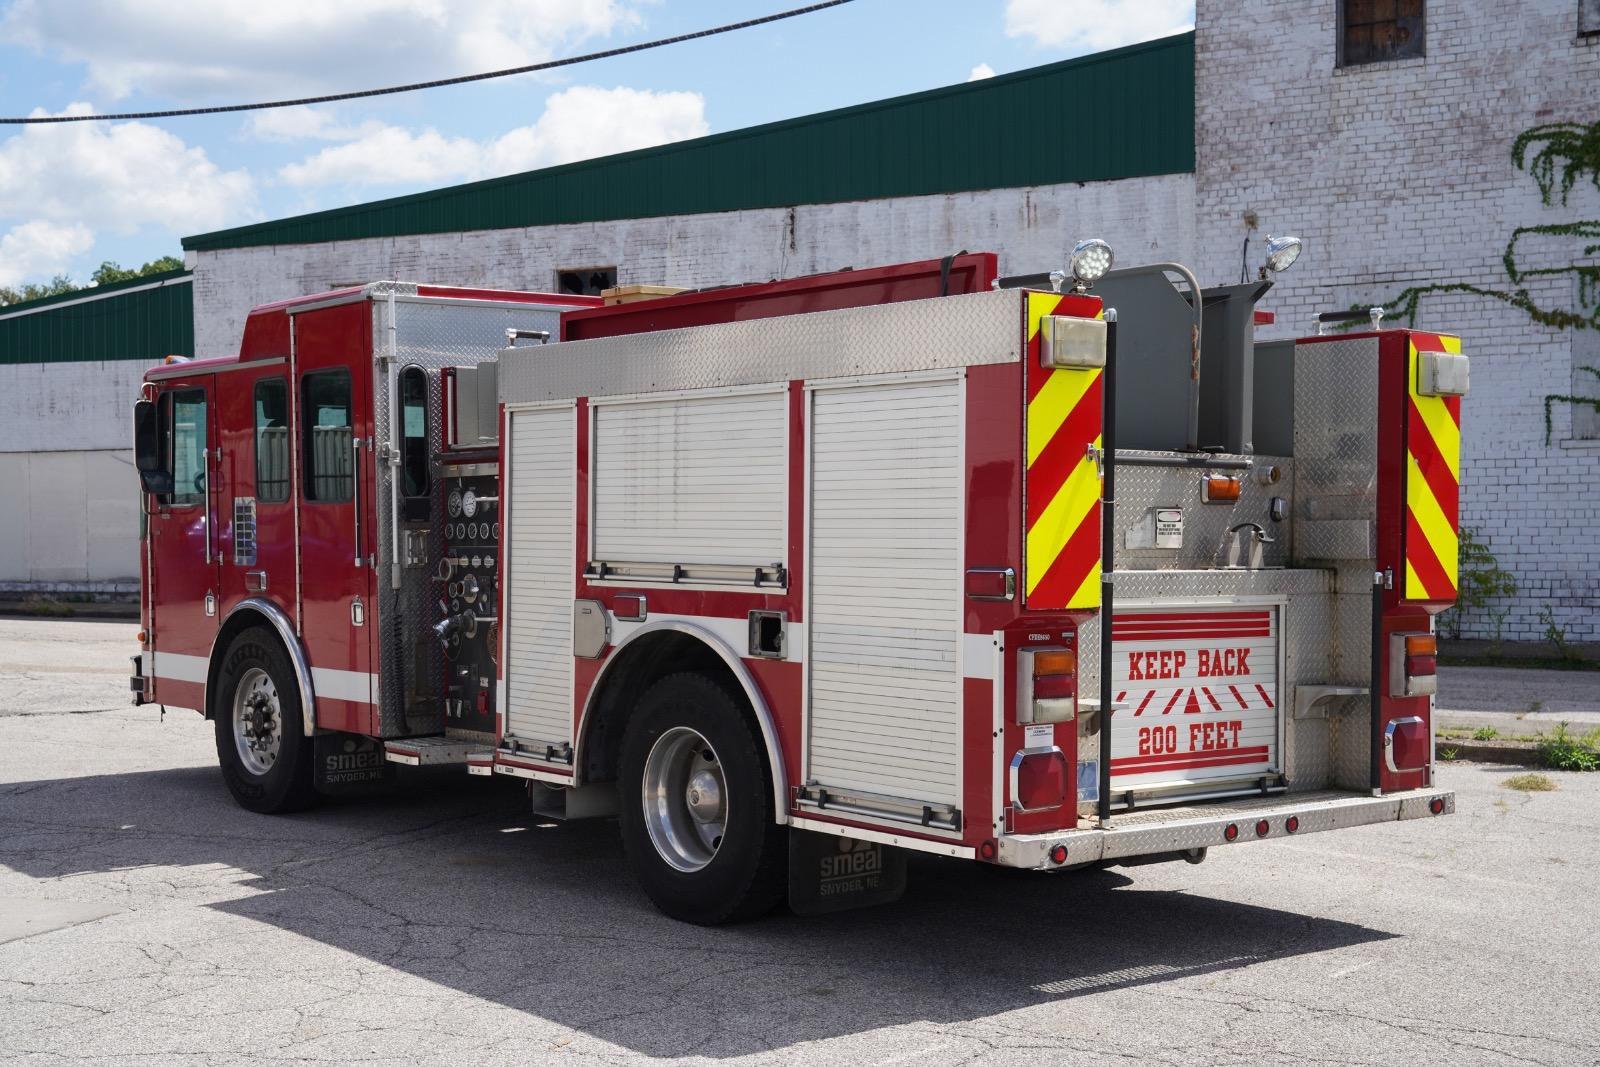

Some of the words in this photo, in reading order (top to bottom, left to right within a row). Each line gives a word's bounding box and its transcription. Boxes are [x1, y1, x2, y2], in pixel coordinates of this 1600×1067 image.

[1128, 651, 1186, 680] KEEP
[1197, 648, 1250, 677] BACK
[1138, 725, 1177, 755] 200
[1189, 720, 1242, 751] FEET
[820, 846, 882, 878] smeal
